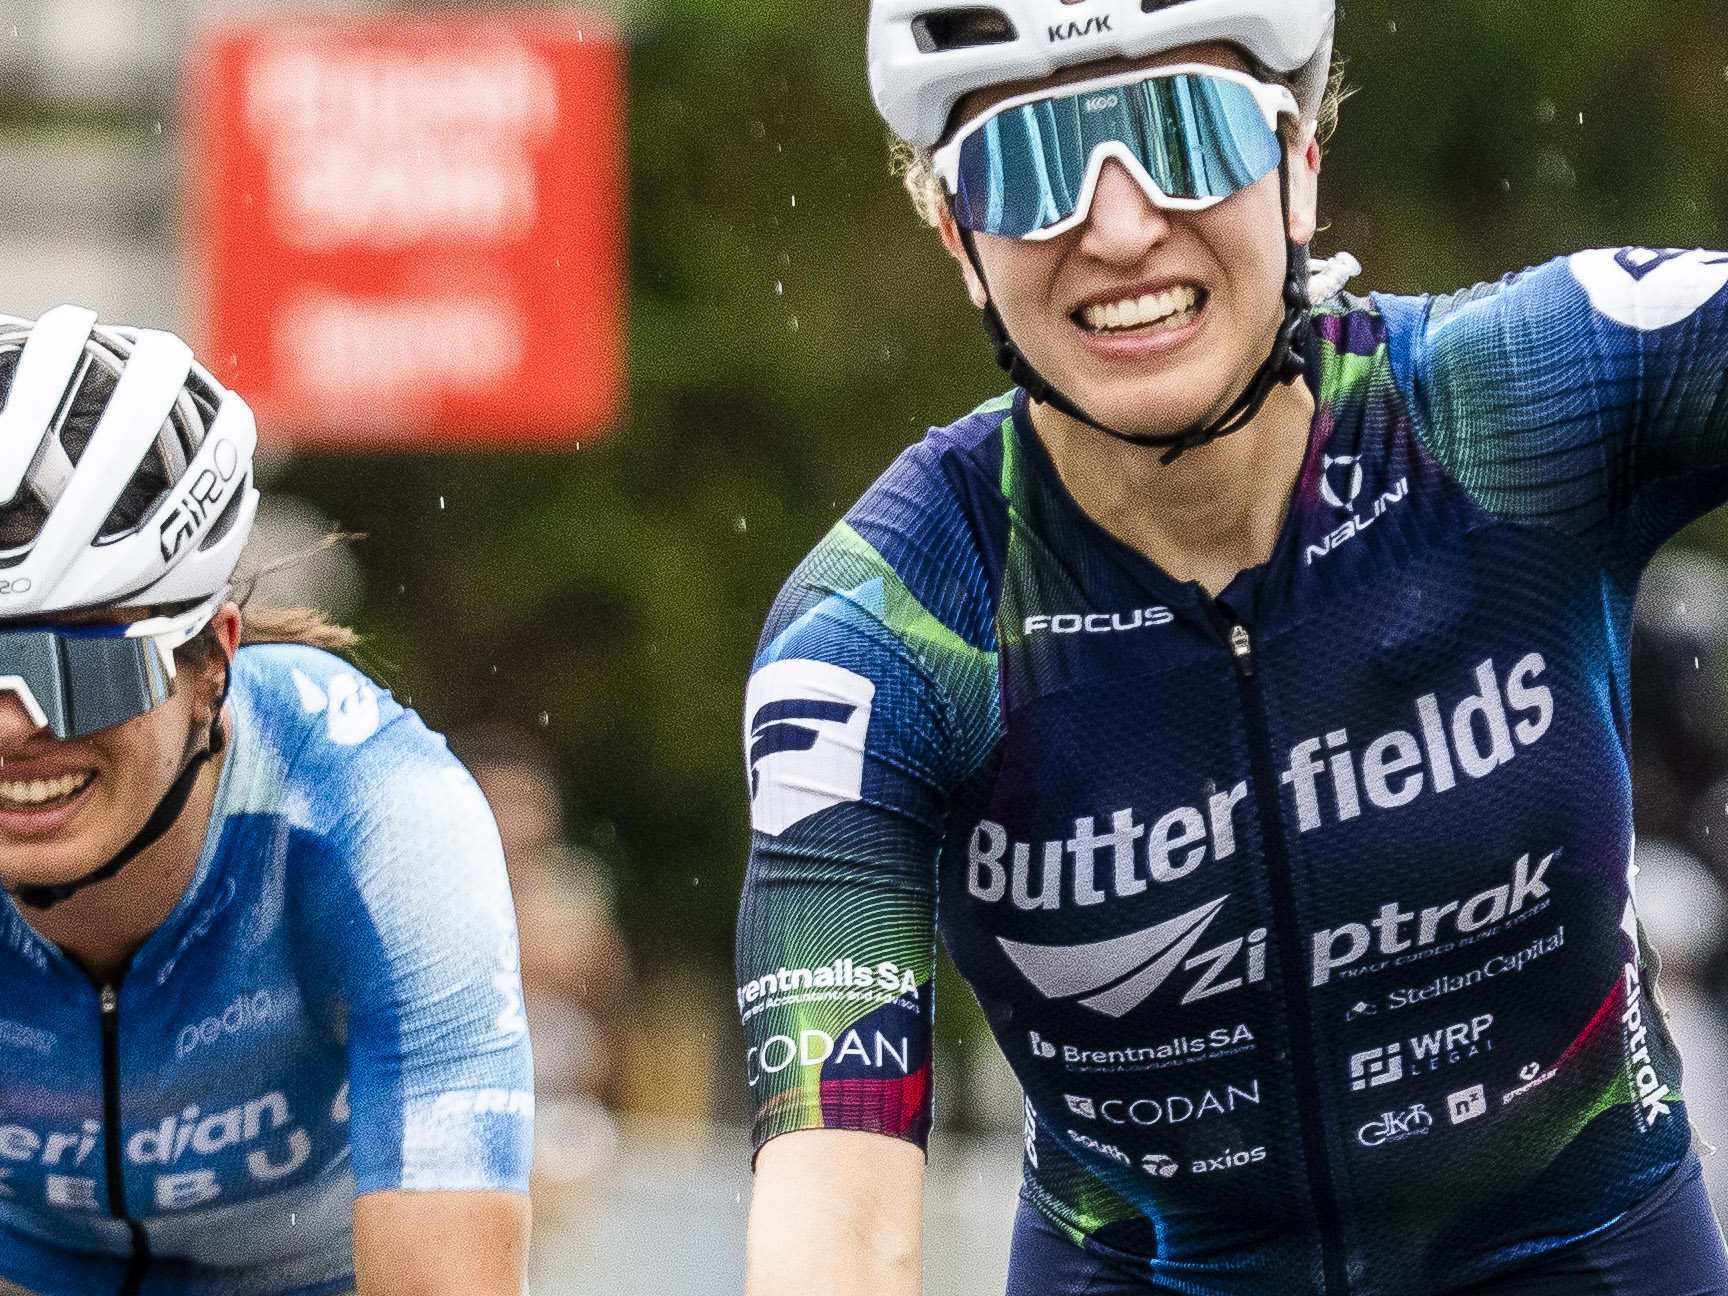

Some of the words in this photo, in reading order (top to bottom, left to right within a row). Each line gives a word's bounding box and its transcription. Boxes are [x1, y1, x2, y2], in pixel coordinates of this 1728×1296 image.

[1048, 14, 1113, 42] KASK
[158, 438, 239, 564] GIRO
[1024, 606, 1174, 635] FOCUS
[737, 958, 873, 1017] rentnalls
[747, 1028, 909, 1087] CODAN
[1409, 1013, 1494, 1059] WRP
[1101, 1079, 1260, 1125] CODAN
[1191, 1146, 1267, 1173] axios
